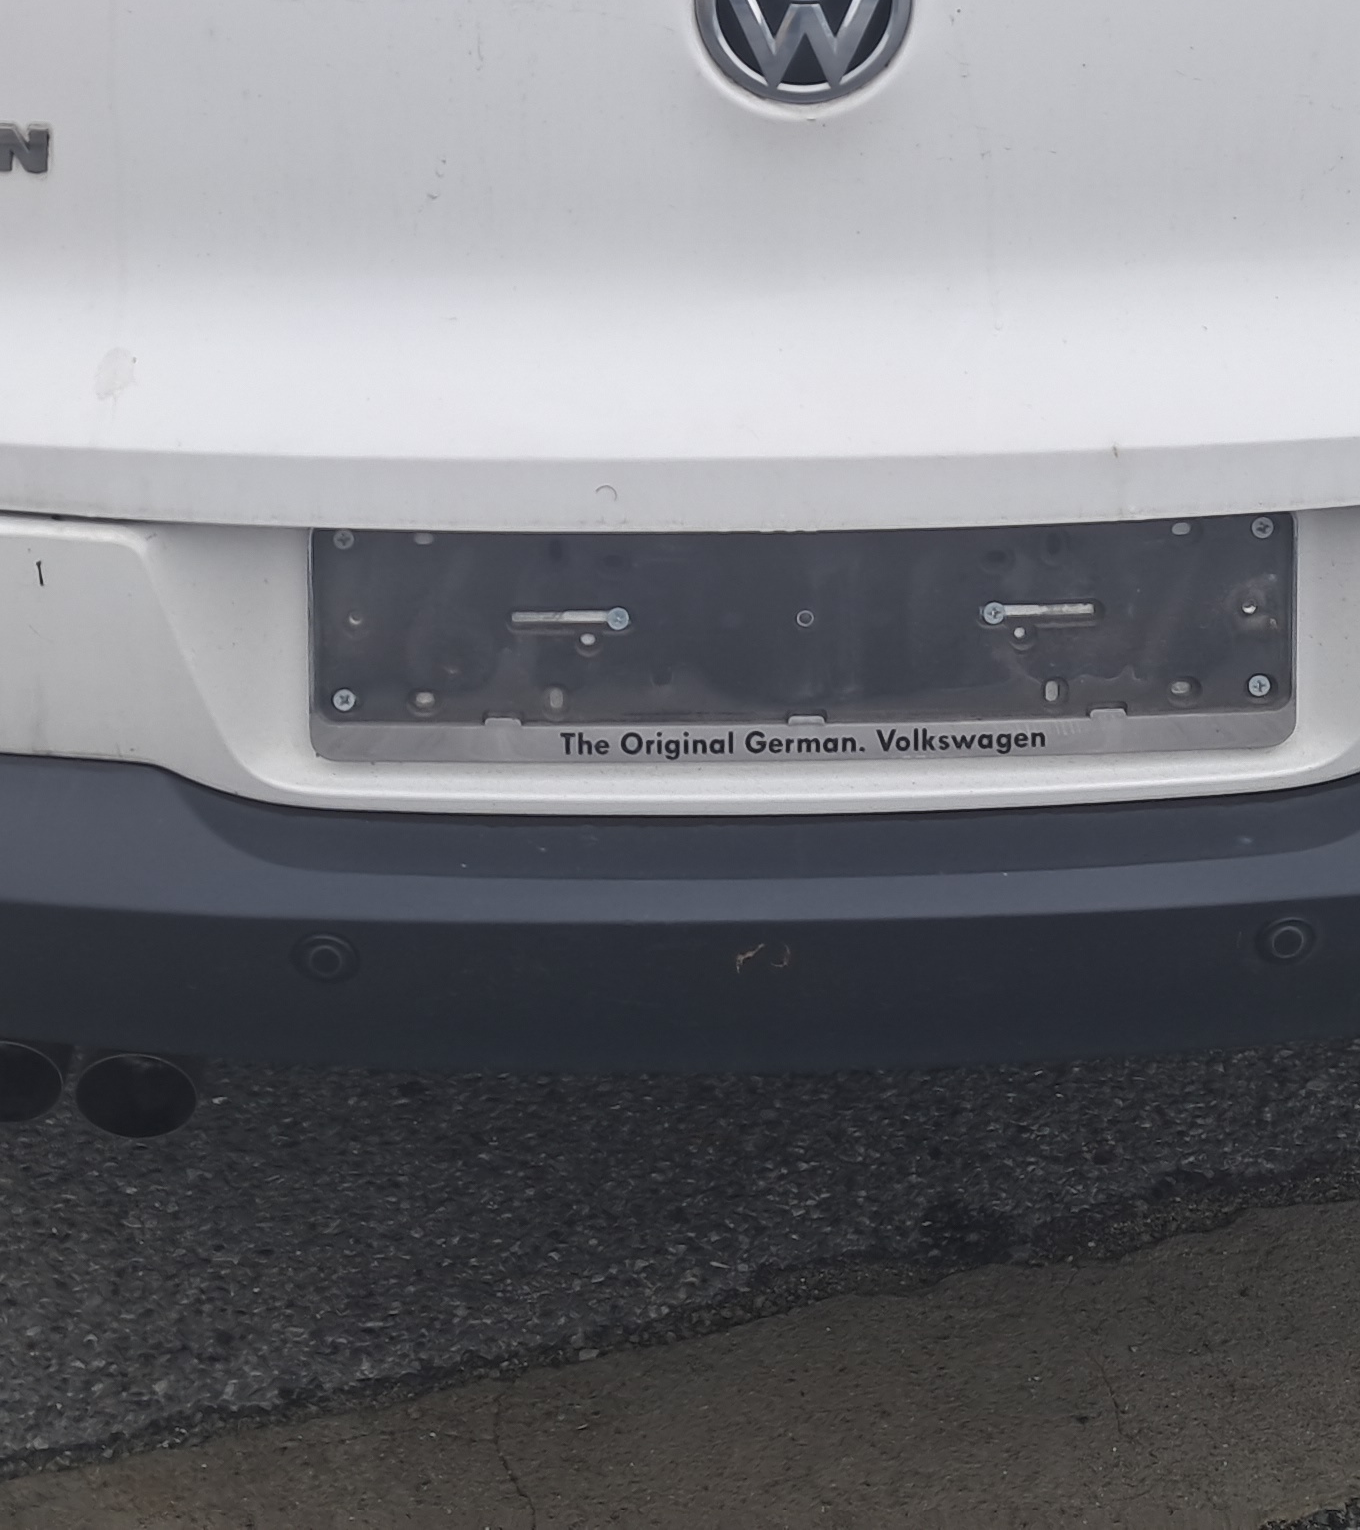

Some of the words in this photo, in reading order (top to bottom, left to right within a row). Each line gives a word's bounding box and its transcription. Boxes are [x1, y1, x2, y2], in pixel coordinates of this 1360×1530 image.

[560, 732, 610, 756] The
[620, 730, 735, 761] Original
[744, 730, 866, 755] German.
[876, 728, 1047, 755] Volkswagen
